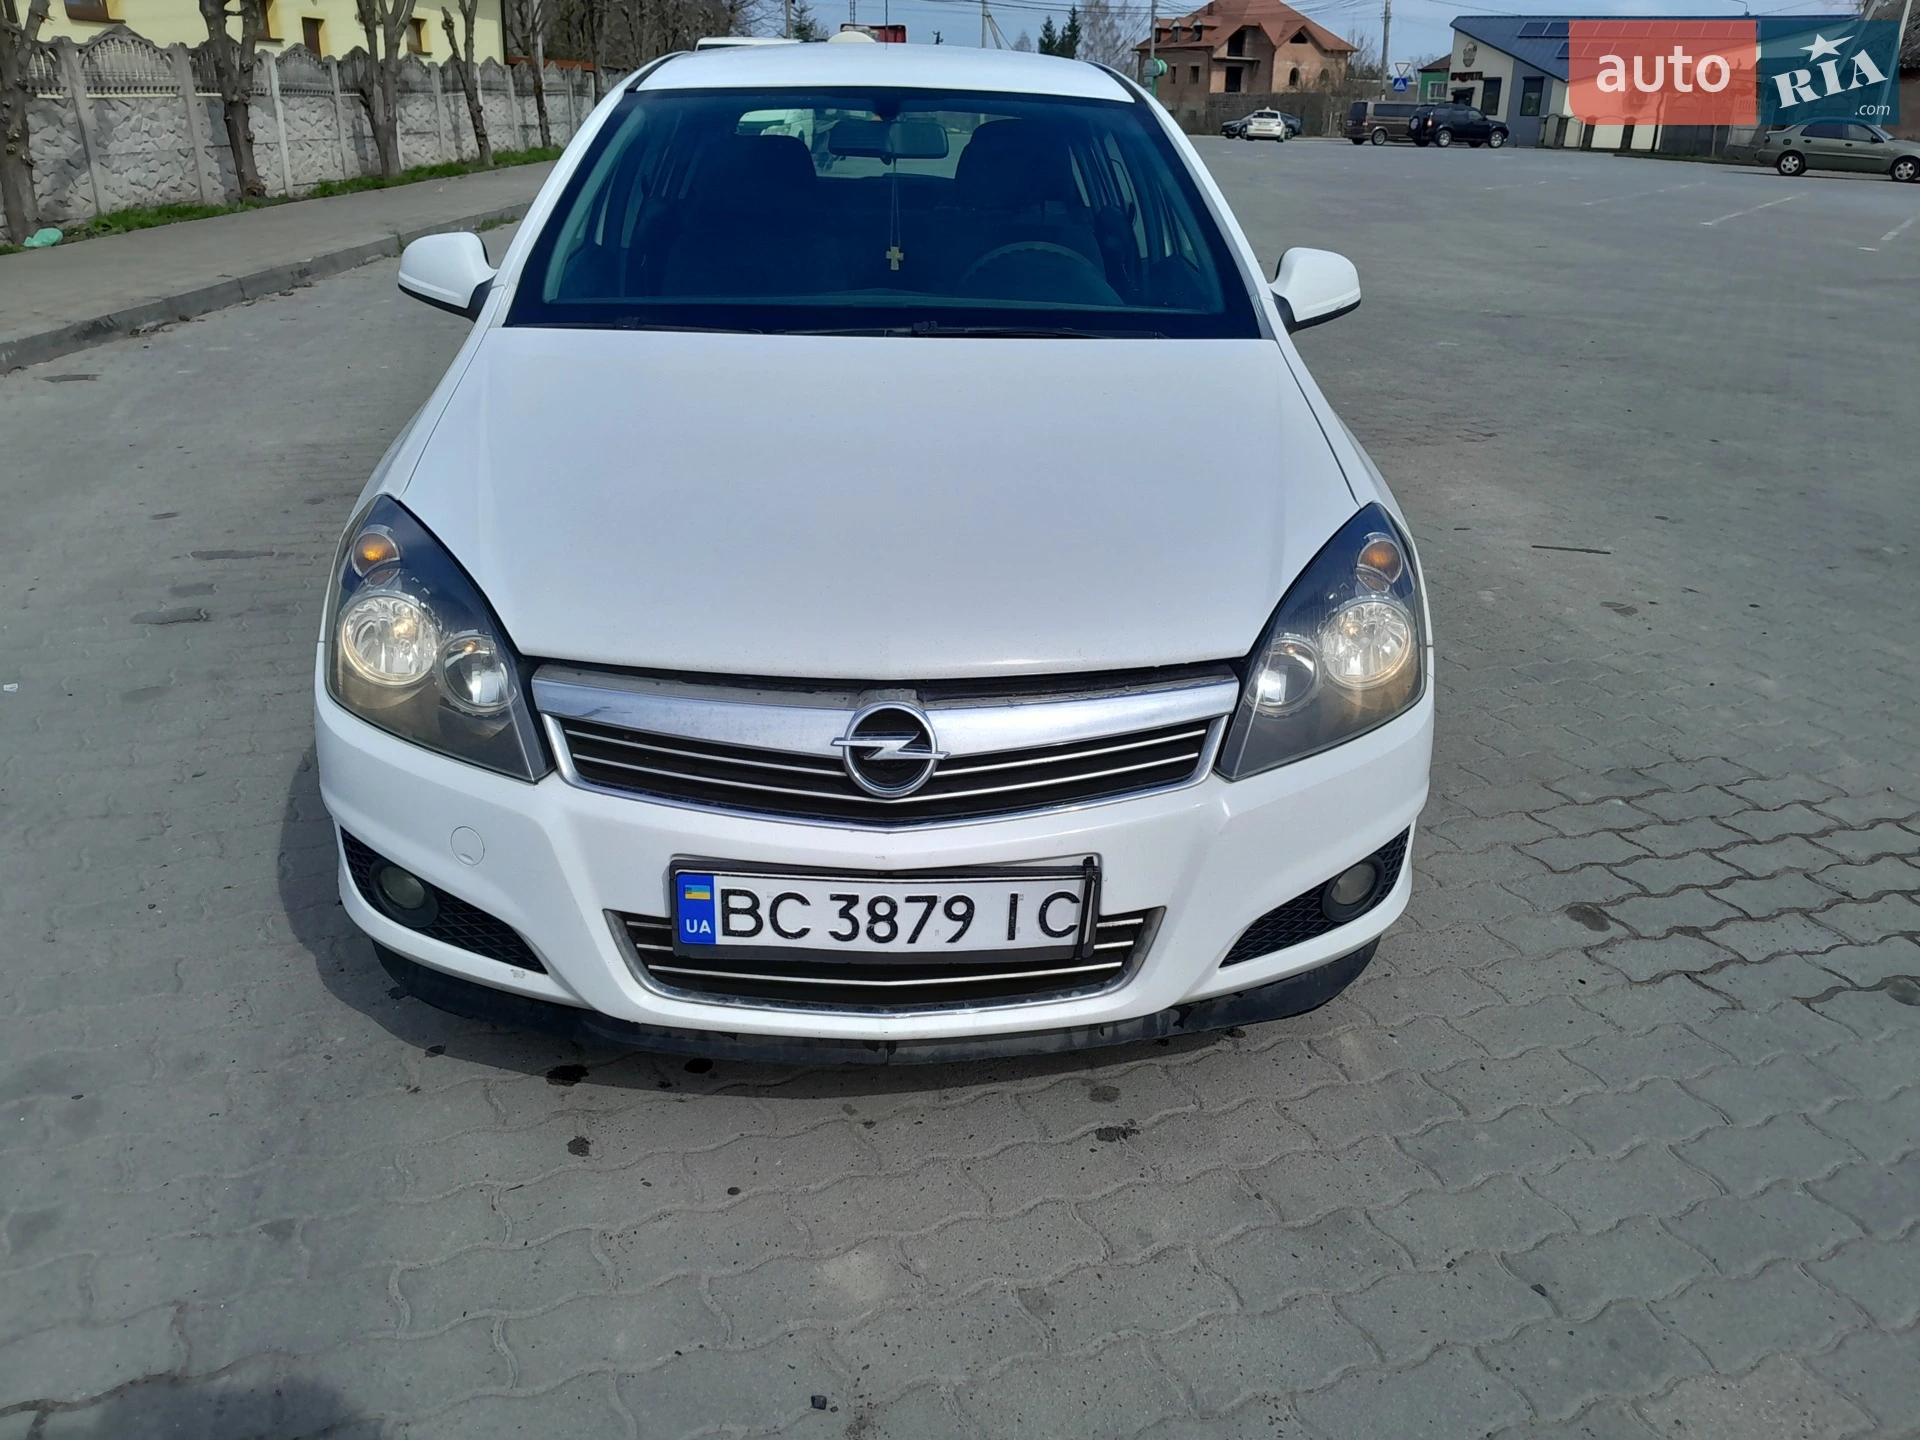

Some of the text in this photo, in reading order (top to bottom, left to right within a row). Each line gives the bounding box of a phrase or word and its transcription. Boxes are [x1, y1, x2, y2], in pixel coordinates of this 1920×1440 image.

[685, 919, 711, 934] UA
[720, 888, 811, 940] BC
[828, 893, 975, 944] 3879
